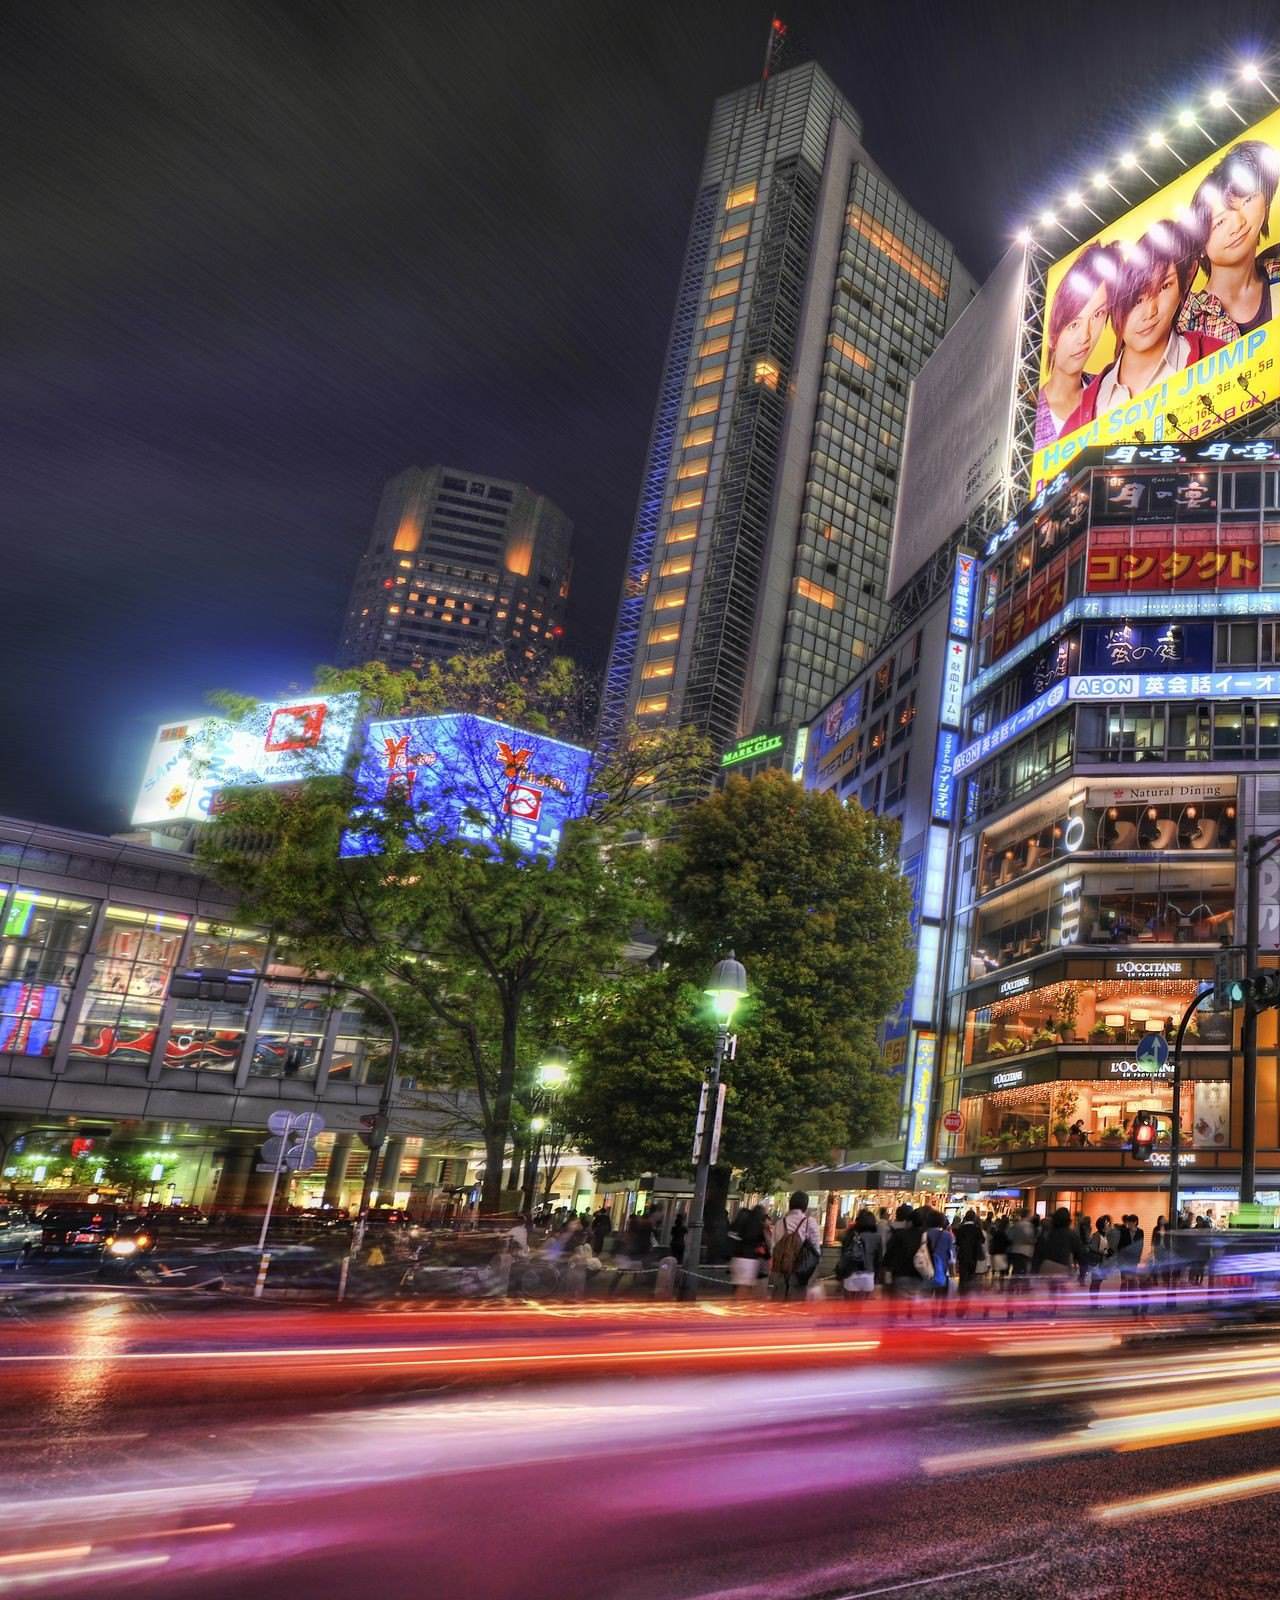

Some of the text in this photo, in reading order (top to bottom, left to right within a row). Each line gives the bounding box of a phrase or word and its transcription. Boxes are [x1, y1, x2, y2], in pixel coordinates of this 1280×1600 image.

[1042, 419, 1100, 472] Hey!
[1108, 383, 1168, 435] Say!
[1179, 329, 1268, 396] JUMP
[1089, 550, 1257, 580] コンタクト
[1075, 679, 1134, 695] AEON
[722, 735, 782, 763] MARK CITY
[1131, 785, 1221, 799] Natural Dining
[1116, 962, 1182, 973] L'OCCITANE
